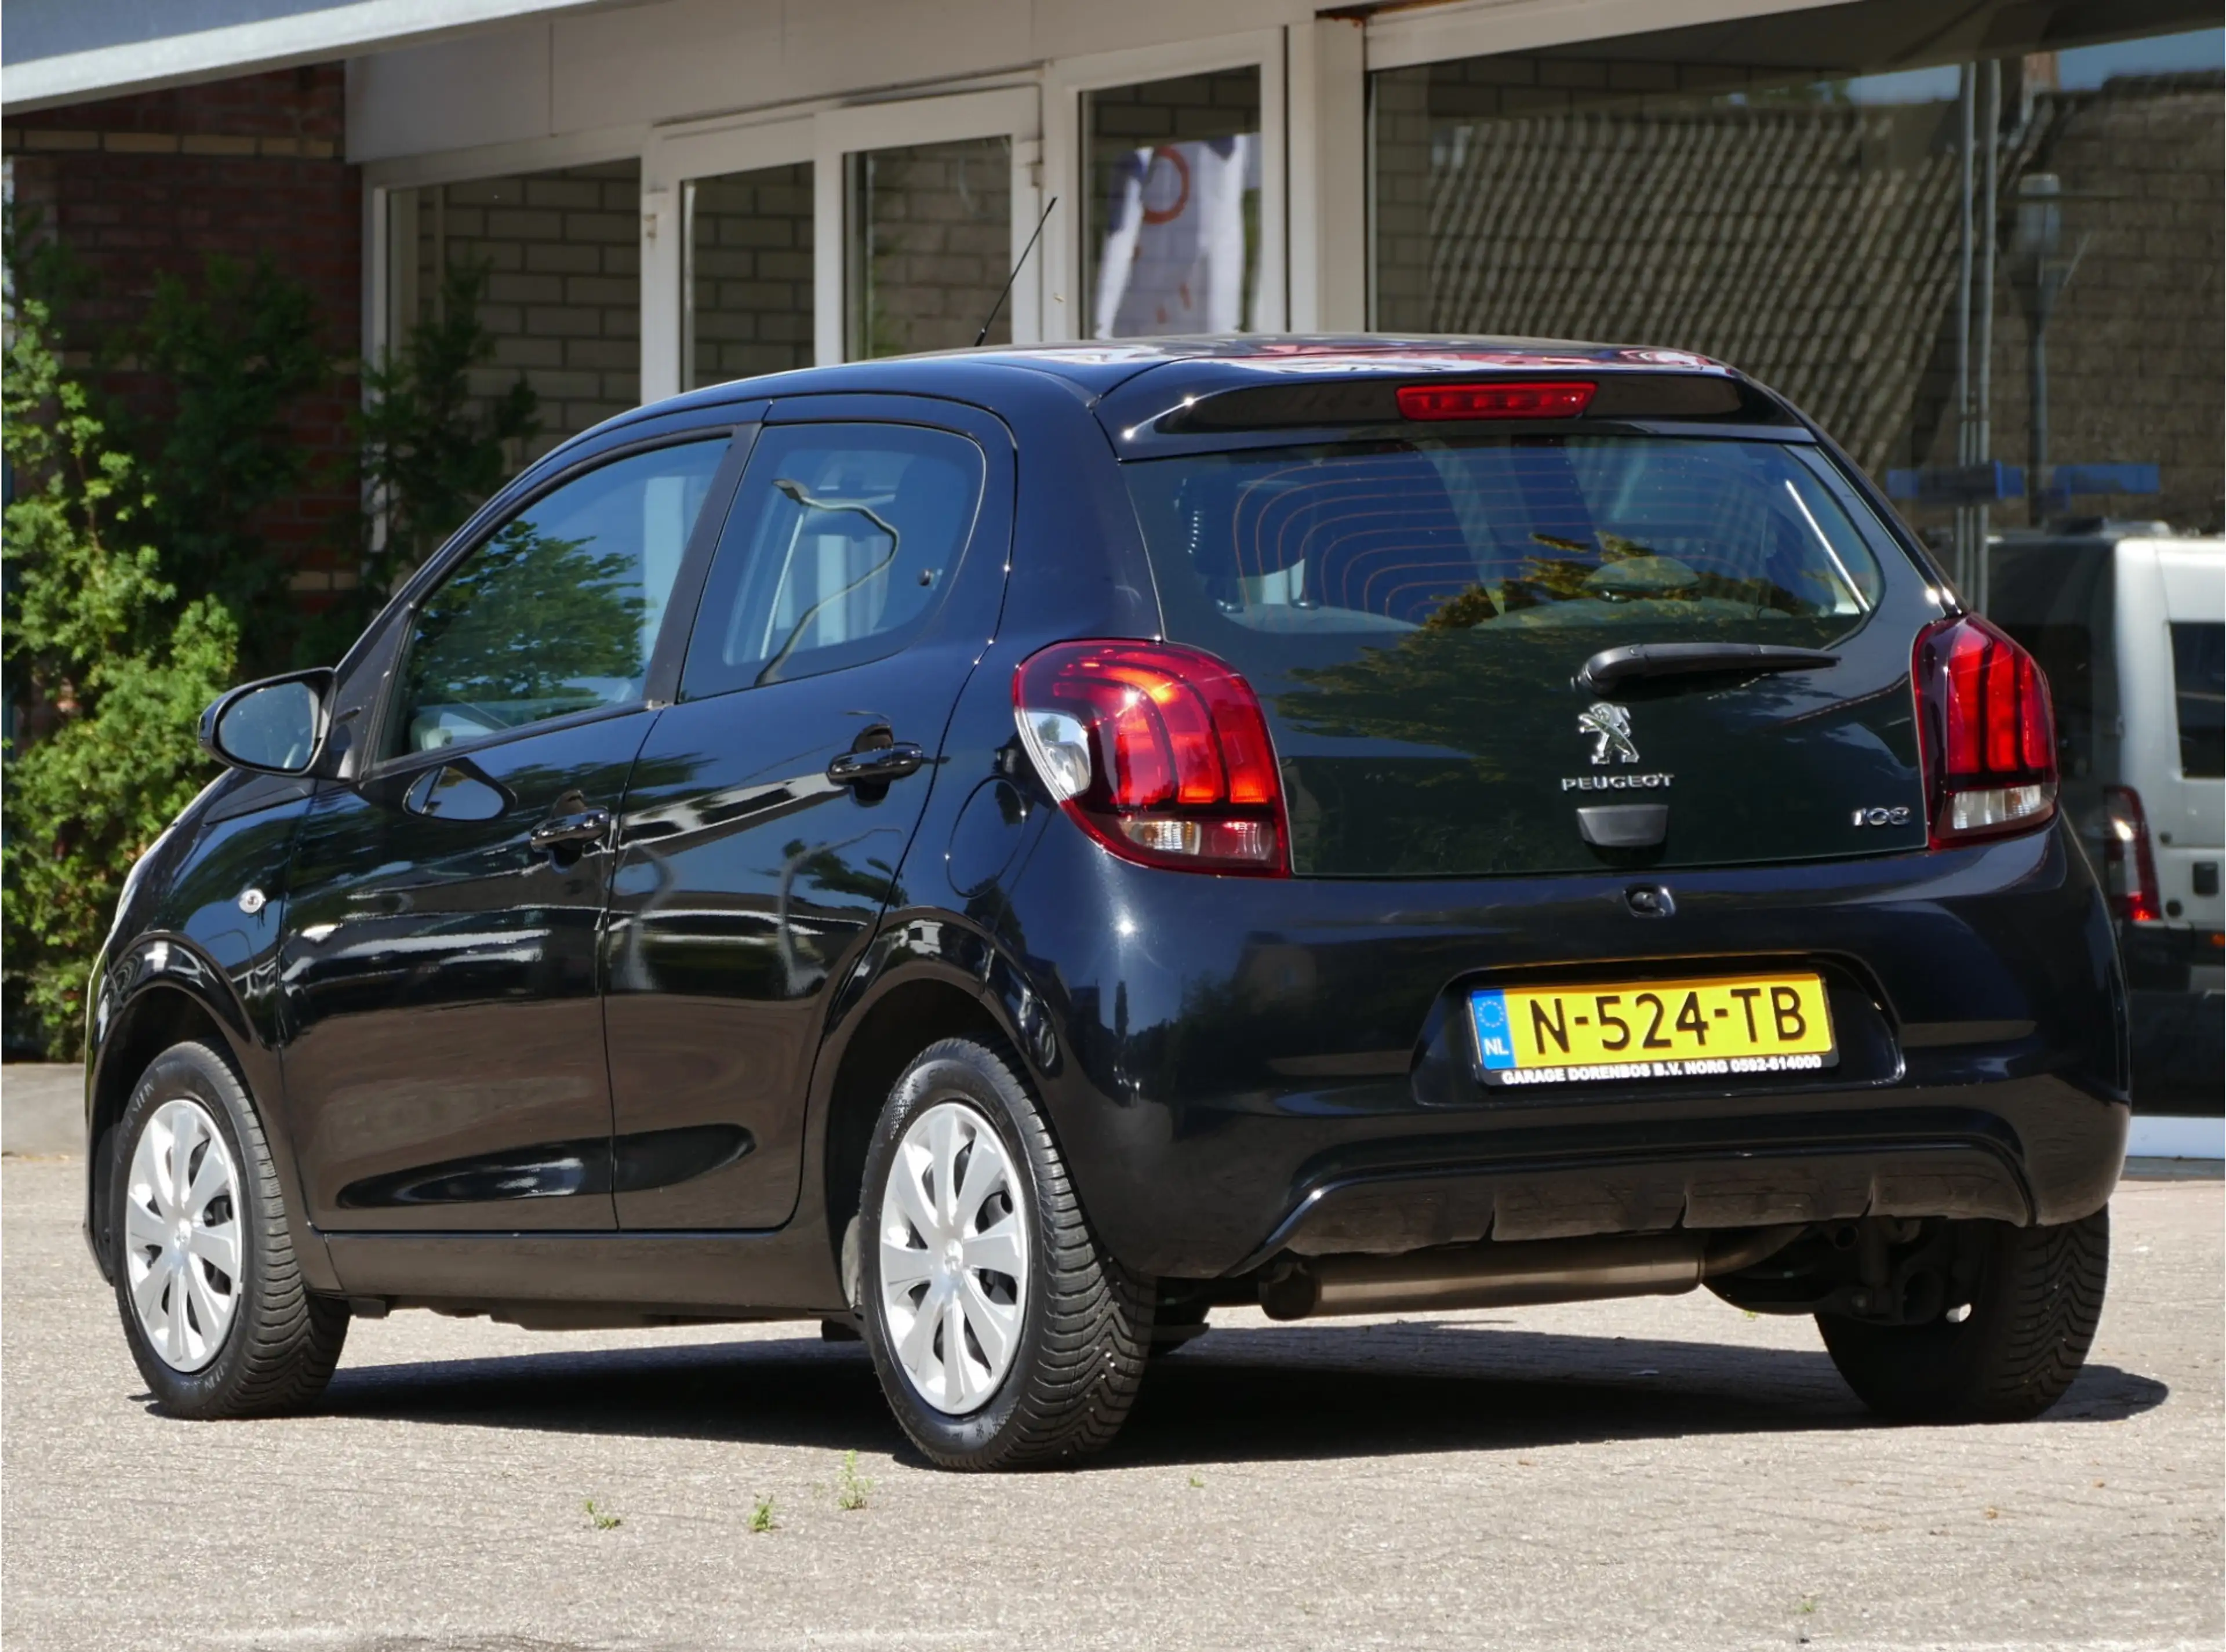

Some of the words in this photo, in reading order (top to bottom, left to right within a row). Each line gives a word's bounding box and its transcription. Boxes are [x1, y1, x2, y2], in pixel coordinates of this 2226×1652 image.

[1561, 773, 1675, 792] PEUGEOT
[1852, 806, 1911, 827] 108
[1530, 986, 1806, 1055] N-524-TB
[1484, 1038, 1510, 1056] NL
[1501, 1068, 1566, 1085] GARAGE
[1567, 1063, 1651, 1082] DORENBOS
[1653, 1061, 1683, 1077] B.V.
[1684, 1059, 1729, 1075] NORG
